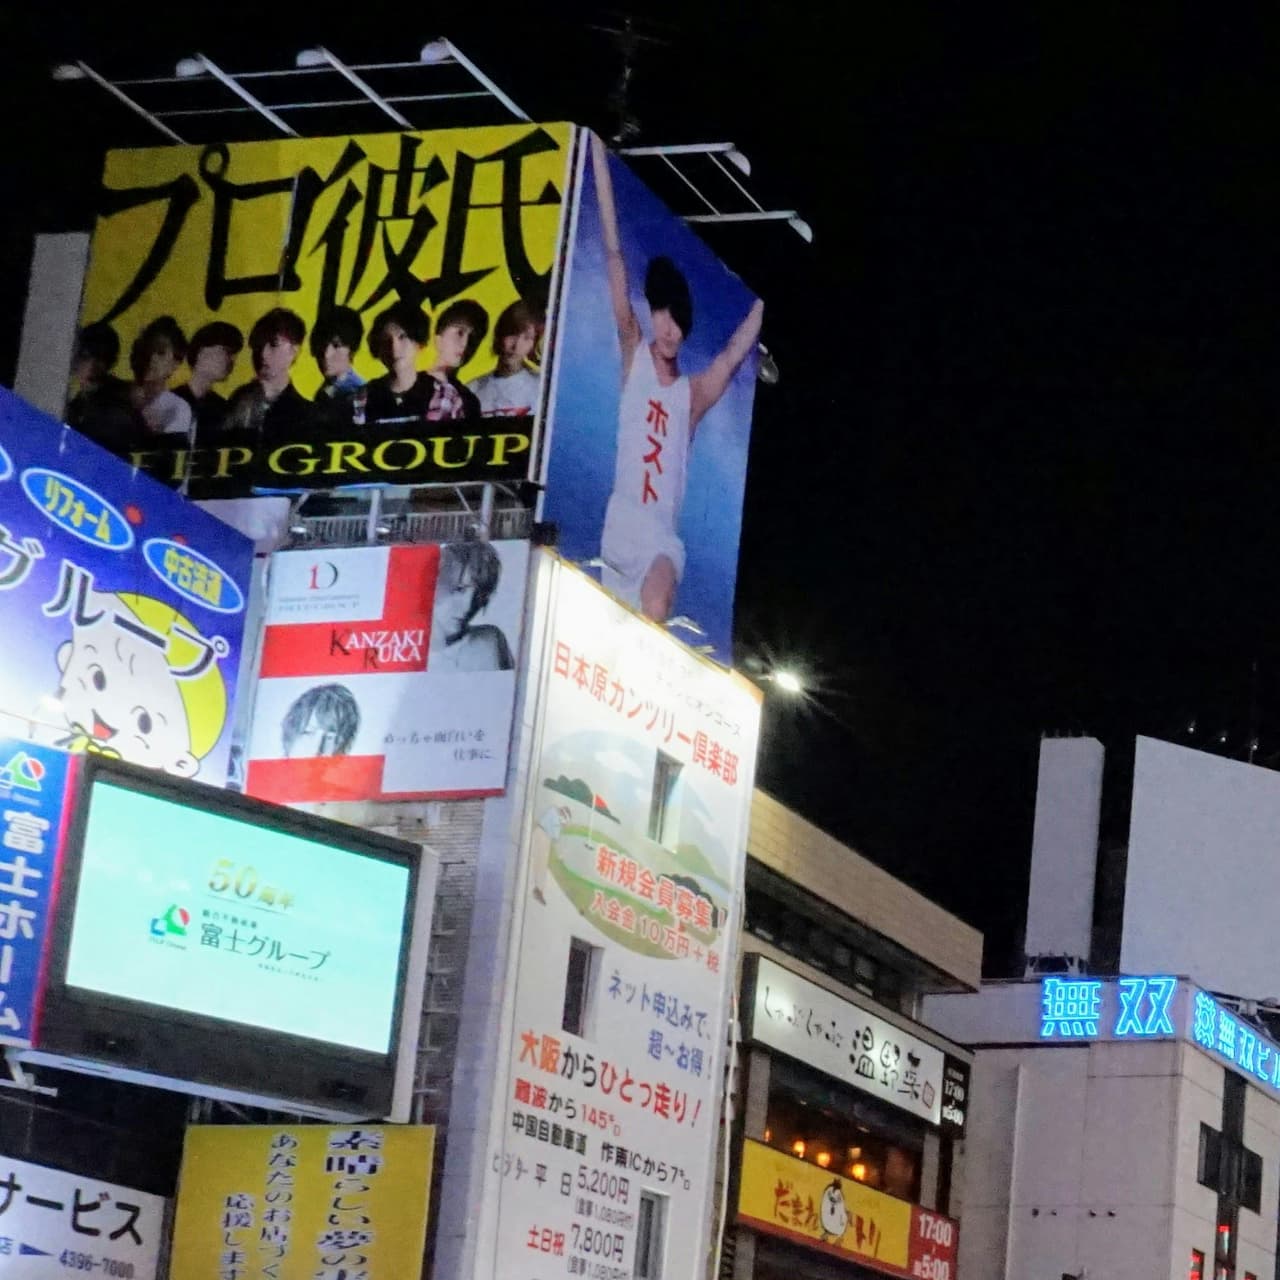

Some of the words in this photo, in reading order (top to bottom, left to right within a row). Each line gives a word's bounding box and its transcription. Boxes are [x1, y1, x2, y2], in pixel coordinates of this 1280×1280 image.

[100, 128, 566, 320] プロ彼氏
[268, 432, 531, 476] GROUP
[641, 400, 671, 504] ホスト
[330, 628, 424, 656] KANZAKI
[364, 645, 422, 669] RUKA
[553, 640, 740, 787] 日本原カンツリー倶楽部
[200, 921, 332, 971] 富士グループ
[1040, 976, 1178, 1038] 無双
[526, 1224, 567, 1257] 土日祝
[919, 1213, 951, 1247] 17:00
